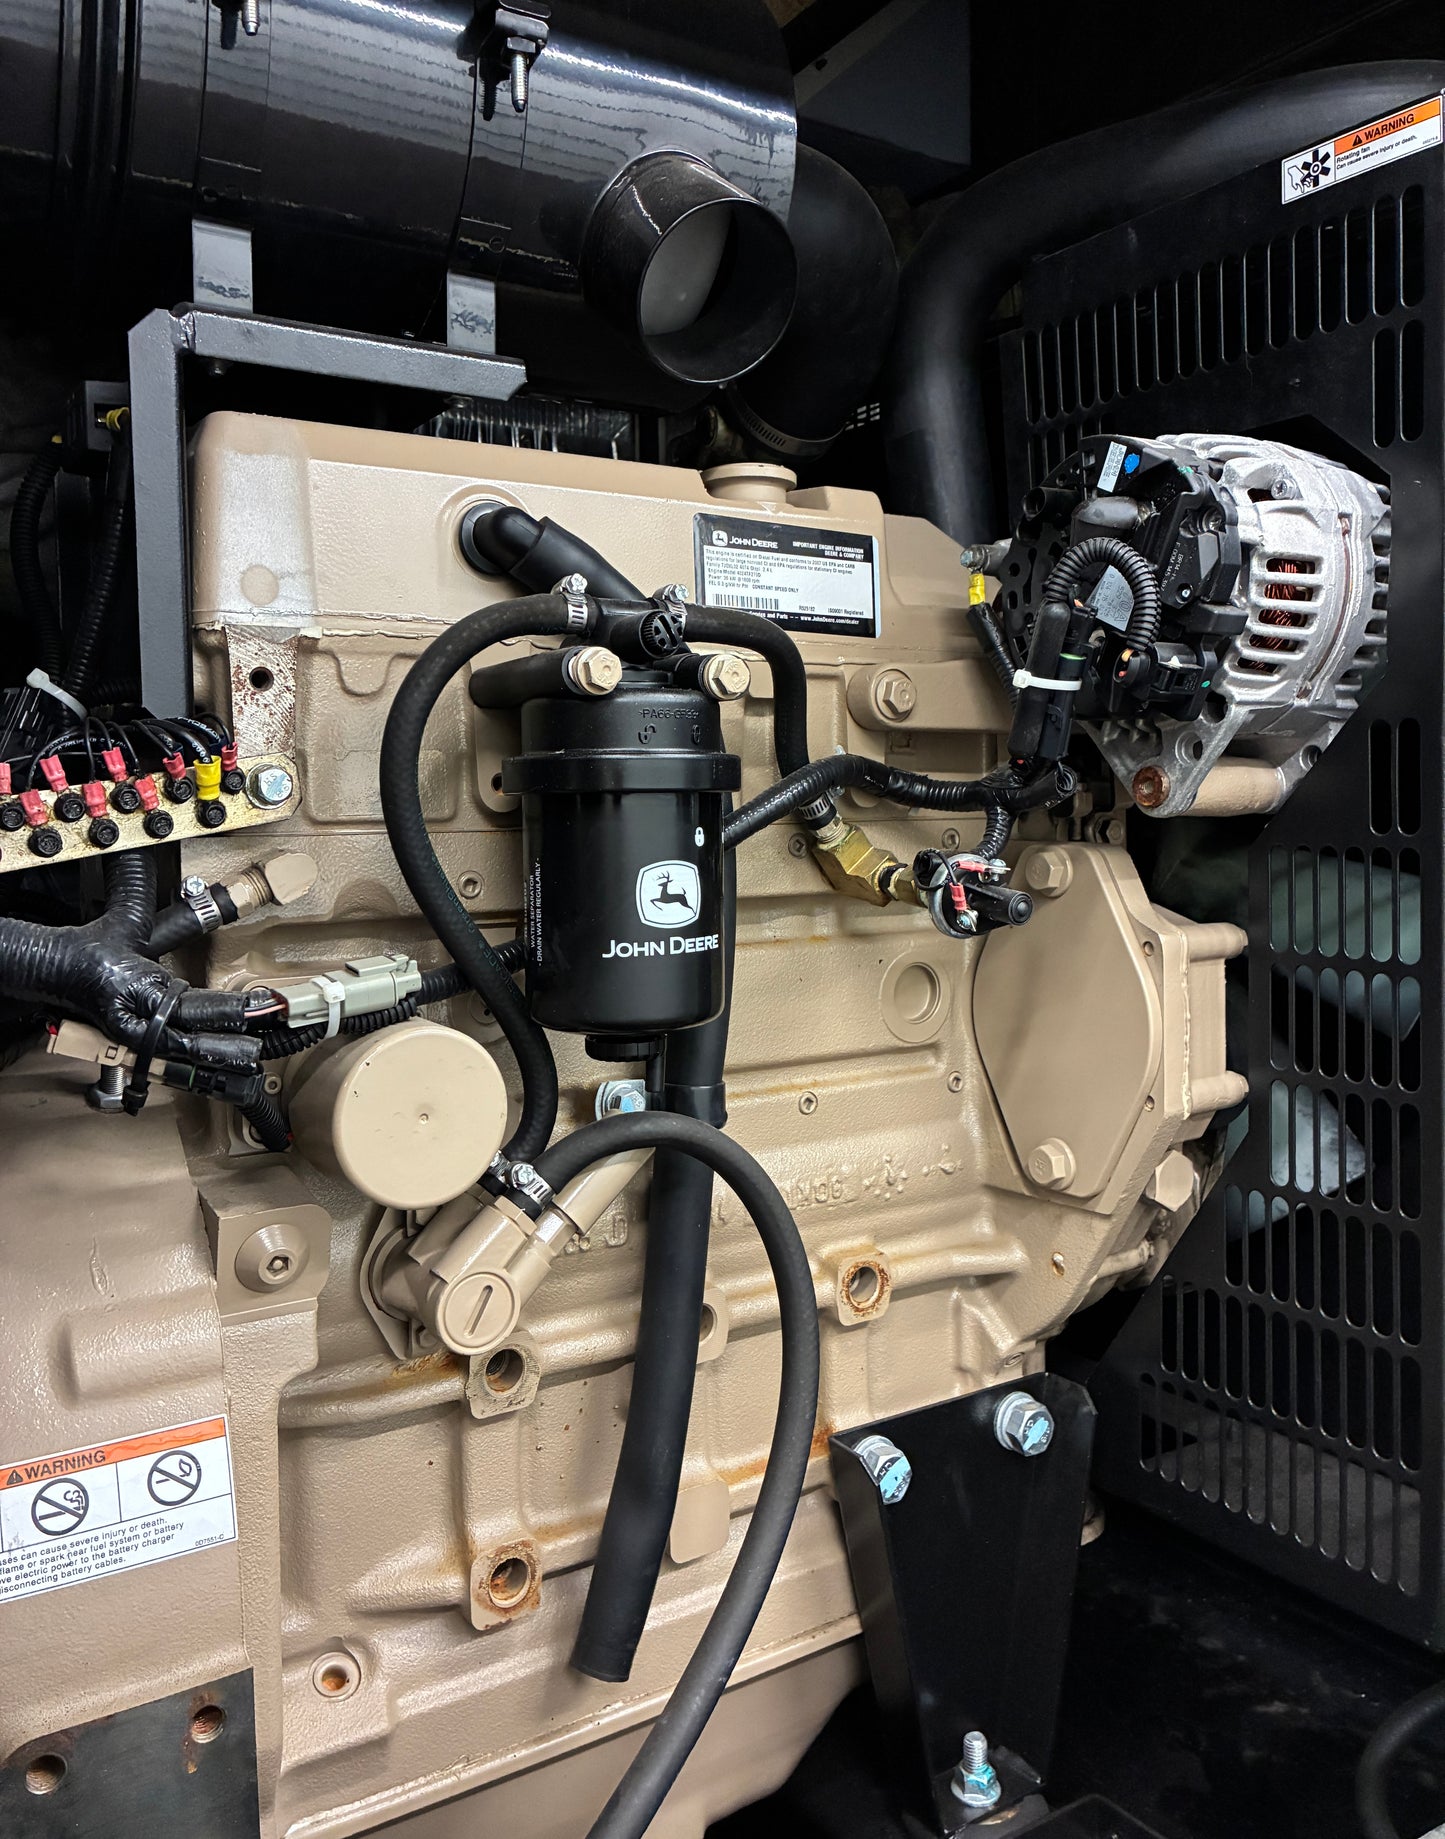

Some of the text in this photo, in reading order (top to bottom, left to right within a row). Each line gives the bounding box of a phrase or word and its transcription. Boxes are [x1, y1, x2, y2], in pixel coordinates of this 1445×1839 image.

[1365, 114, 1414, 140] WARNING
[1337, 150, 1360, 163] Rotating
[1347, 157, 1361, 165] cause
[1362, 150, 1378, 160] severe
[1380, 144, 1394, 153] injury
[729, 536, 778, 549] JOHN DEERE
[793, 541, 818, 549] IMPORTANT
[835, 545, 864, 554] INFORMATION
[844, 552, 864, 560] COMPANY
[602, 934, 719, 959] JOHN DEERE
[24, 1450, 106, 1480] WARNING
[21, 1551, 37, 1561] can
[40, 1544, 67, 1556] cause
[69, 1535, 99, 1549] severe
[102, 1528, 126, 1541] injury
[129, 1525, 138, 1533] or
[141, 1517, 167, 1530] death.
[28, 1560, 36, 1569] or
[40, 1553, 65, 1566] spark
[68, 1547, 87, 1559] near
[90, 1541, 106, 1552] fuel
[109, 1532, 140, 1547] system
[143, 1529, 152, 1538] or
[154, 1522, 184, 1536] battery
[15, 1567, 48, 1581] electric
[51, 1559, 78, 1573] power
[81, 1556, 89, 1564] to
[92, 1551, 105, 1561] the
[109, 1543, 139, 1557] battery
[142, 1533, 175, 1548] charger
[61, 1564, 92, 1579] battery
[95, 1555, 126, 1570] cables.
